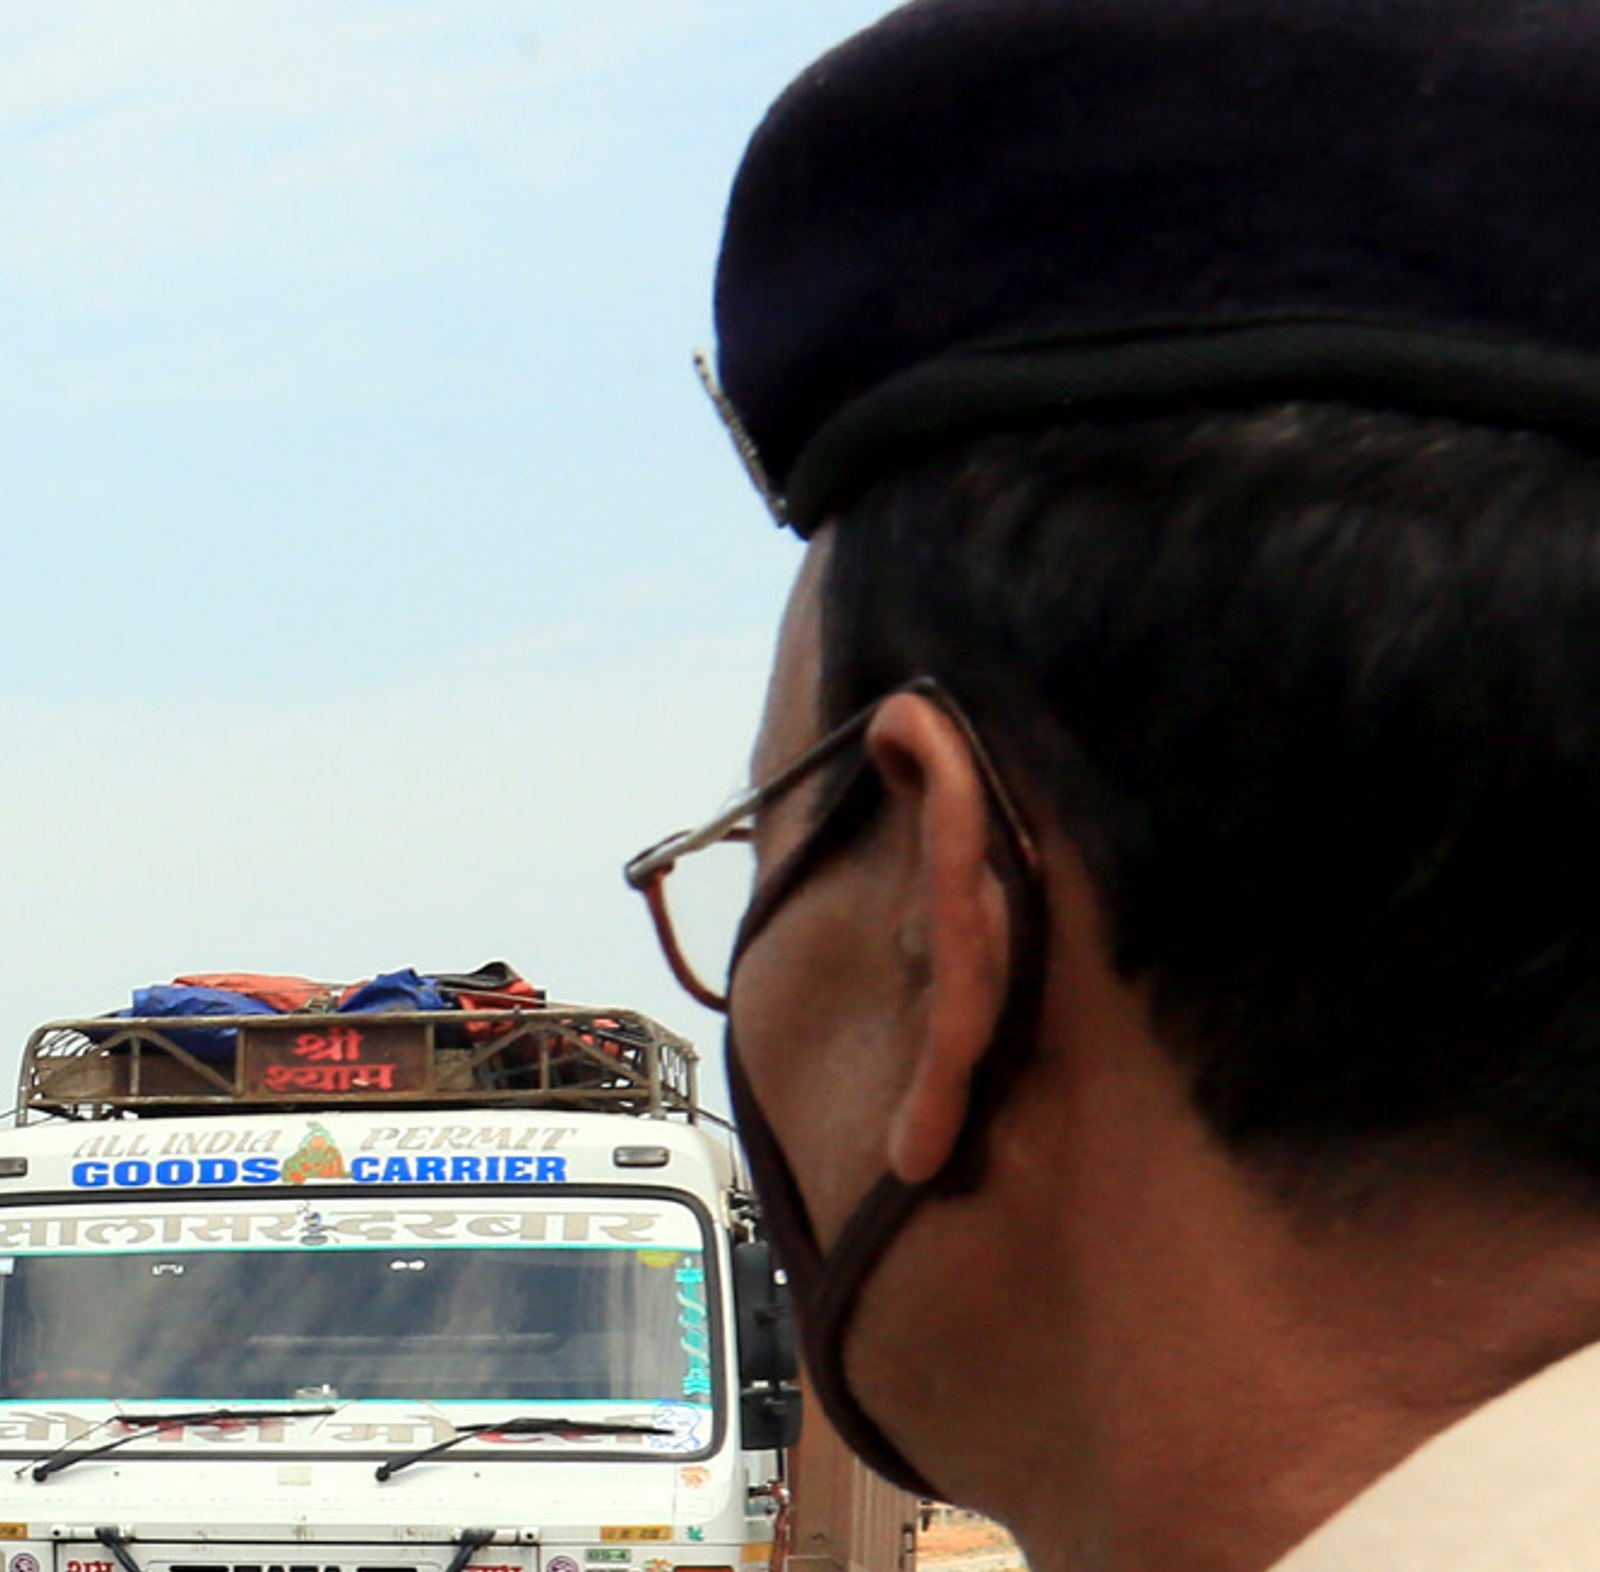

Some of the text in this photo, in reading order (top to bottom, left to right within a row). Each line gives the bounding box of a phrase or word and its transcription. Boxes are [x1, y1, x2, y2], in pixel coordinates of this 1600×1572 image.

[294, 1026, 363, 1061] श्री
[266, 1063, 397, 1091] श्याम
[72, 1125, 580, 1158] ALL INDIA PERMIT
[72, 1155, 568, 1188] GOODS CARRIER
